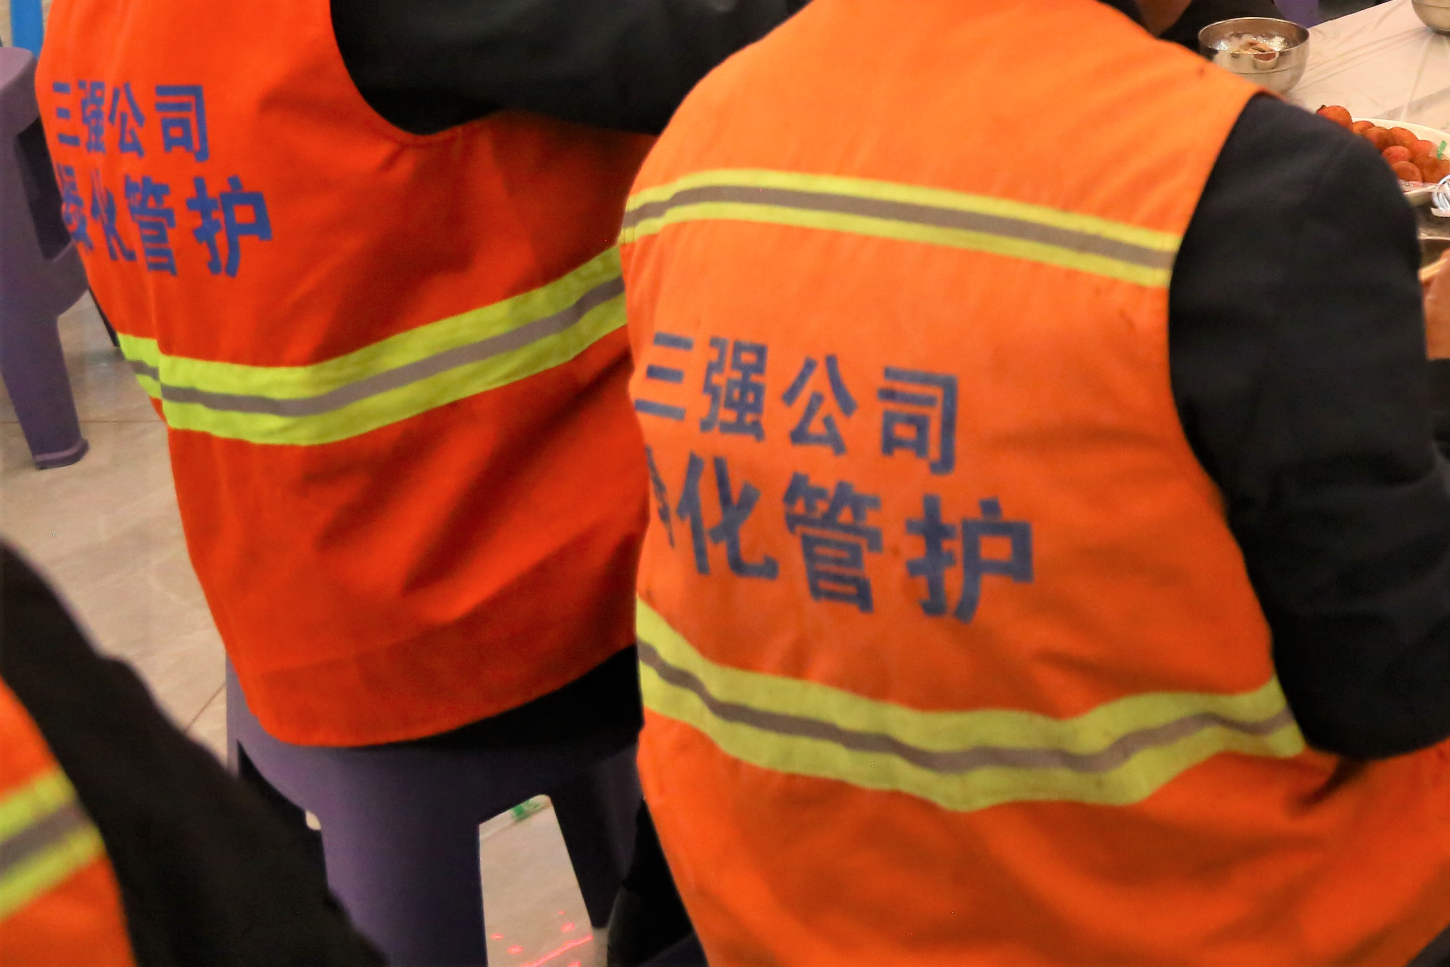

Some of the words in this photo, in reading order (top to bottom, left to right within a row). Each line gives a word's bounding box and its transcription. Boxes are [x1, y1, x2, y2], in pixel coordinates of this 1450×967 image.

[52, 79, 209, 163] 三强公司
[56, 163, 273, 278] 绿化管护
[634, 331, 959, 476] 三强公司
